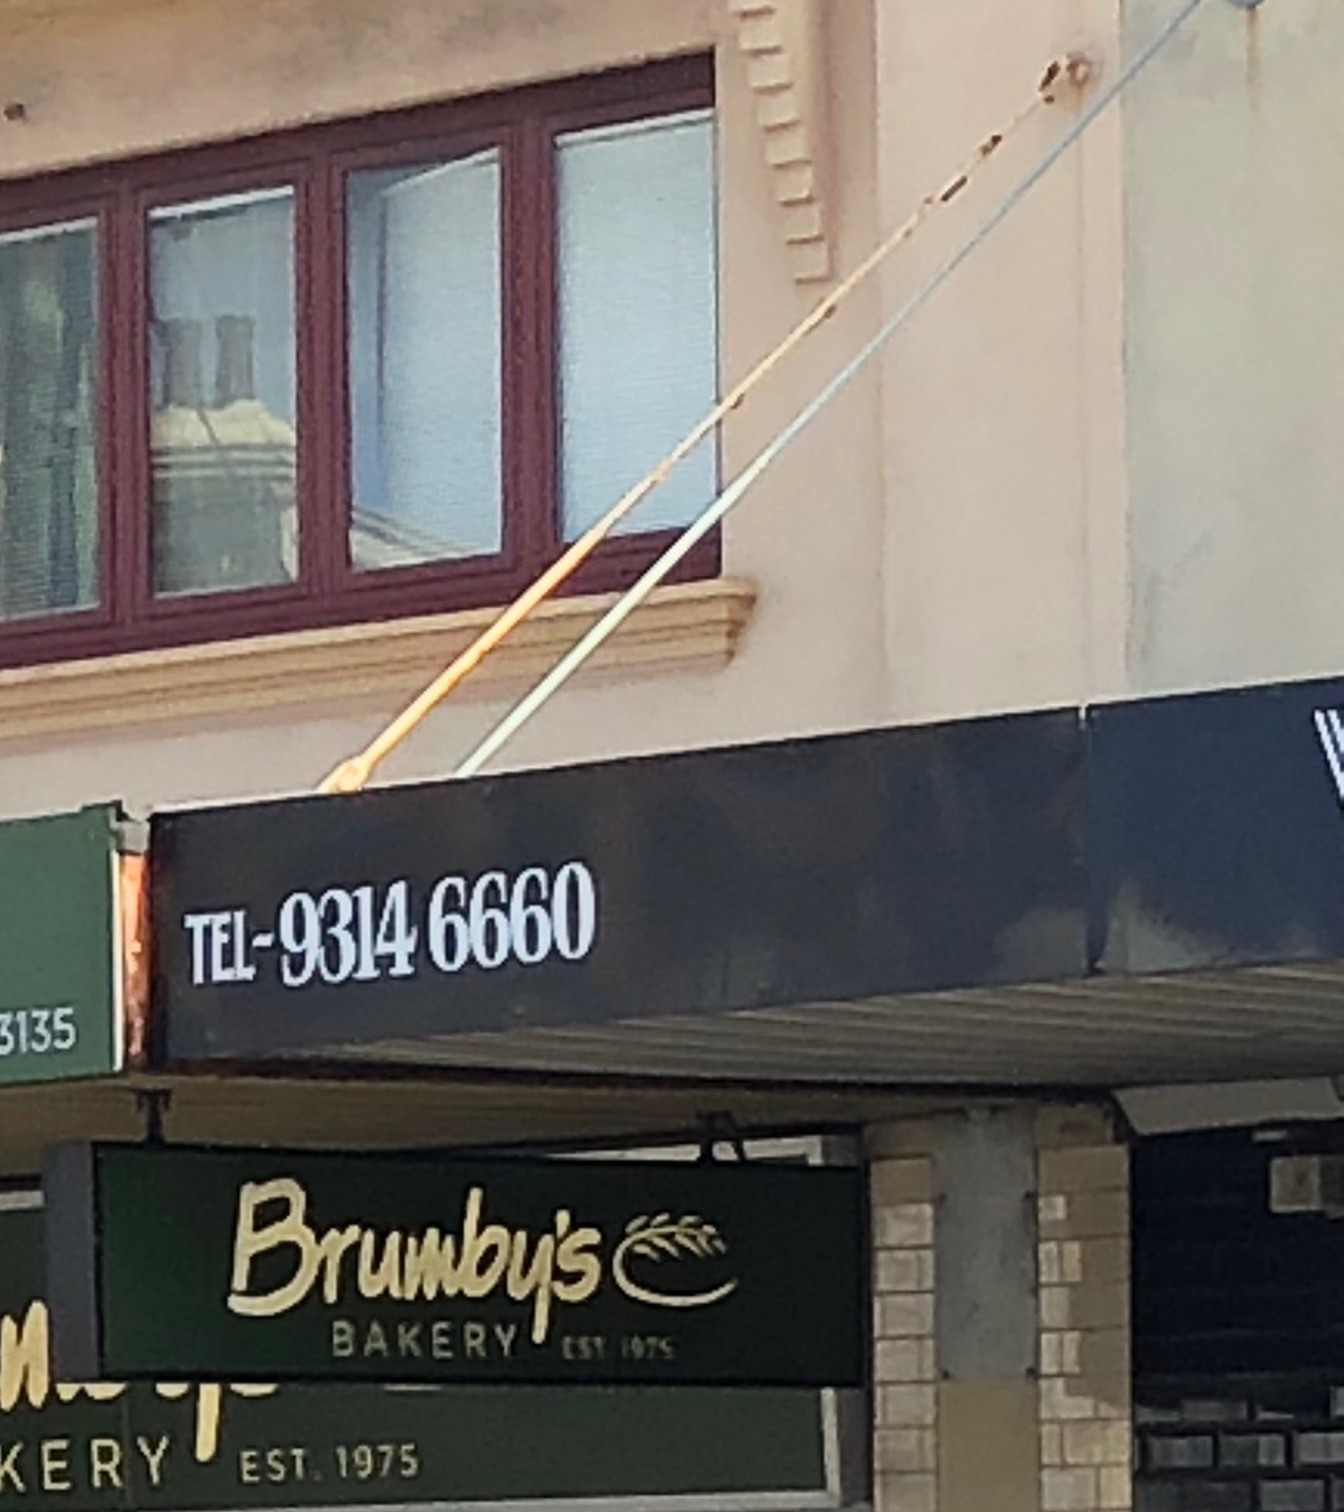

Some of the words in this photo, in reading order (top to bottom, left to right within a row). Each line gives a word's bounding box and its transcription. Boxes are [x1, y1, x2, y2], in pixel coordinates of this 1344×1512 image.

[429, 862, 595, 971] 6660
[226, 1176, 603, 1344] Brumby's
[331, 1319, 518, 1360] BAKERY
[335, 1443, 420, 1479] 1975
